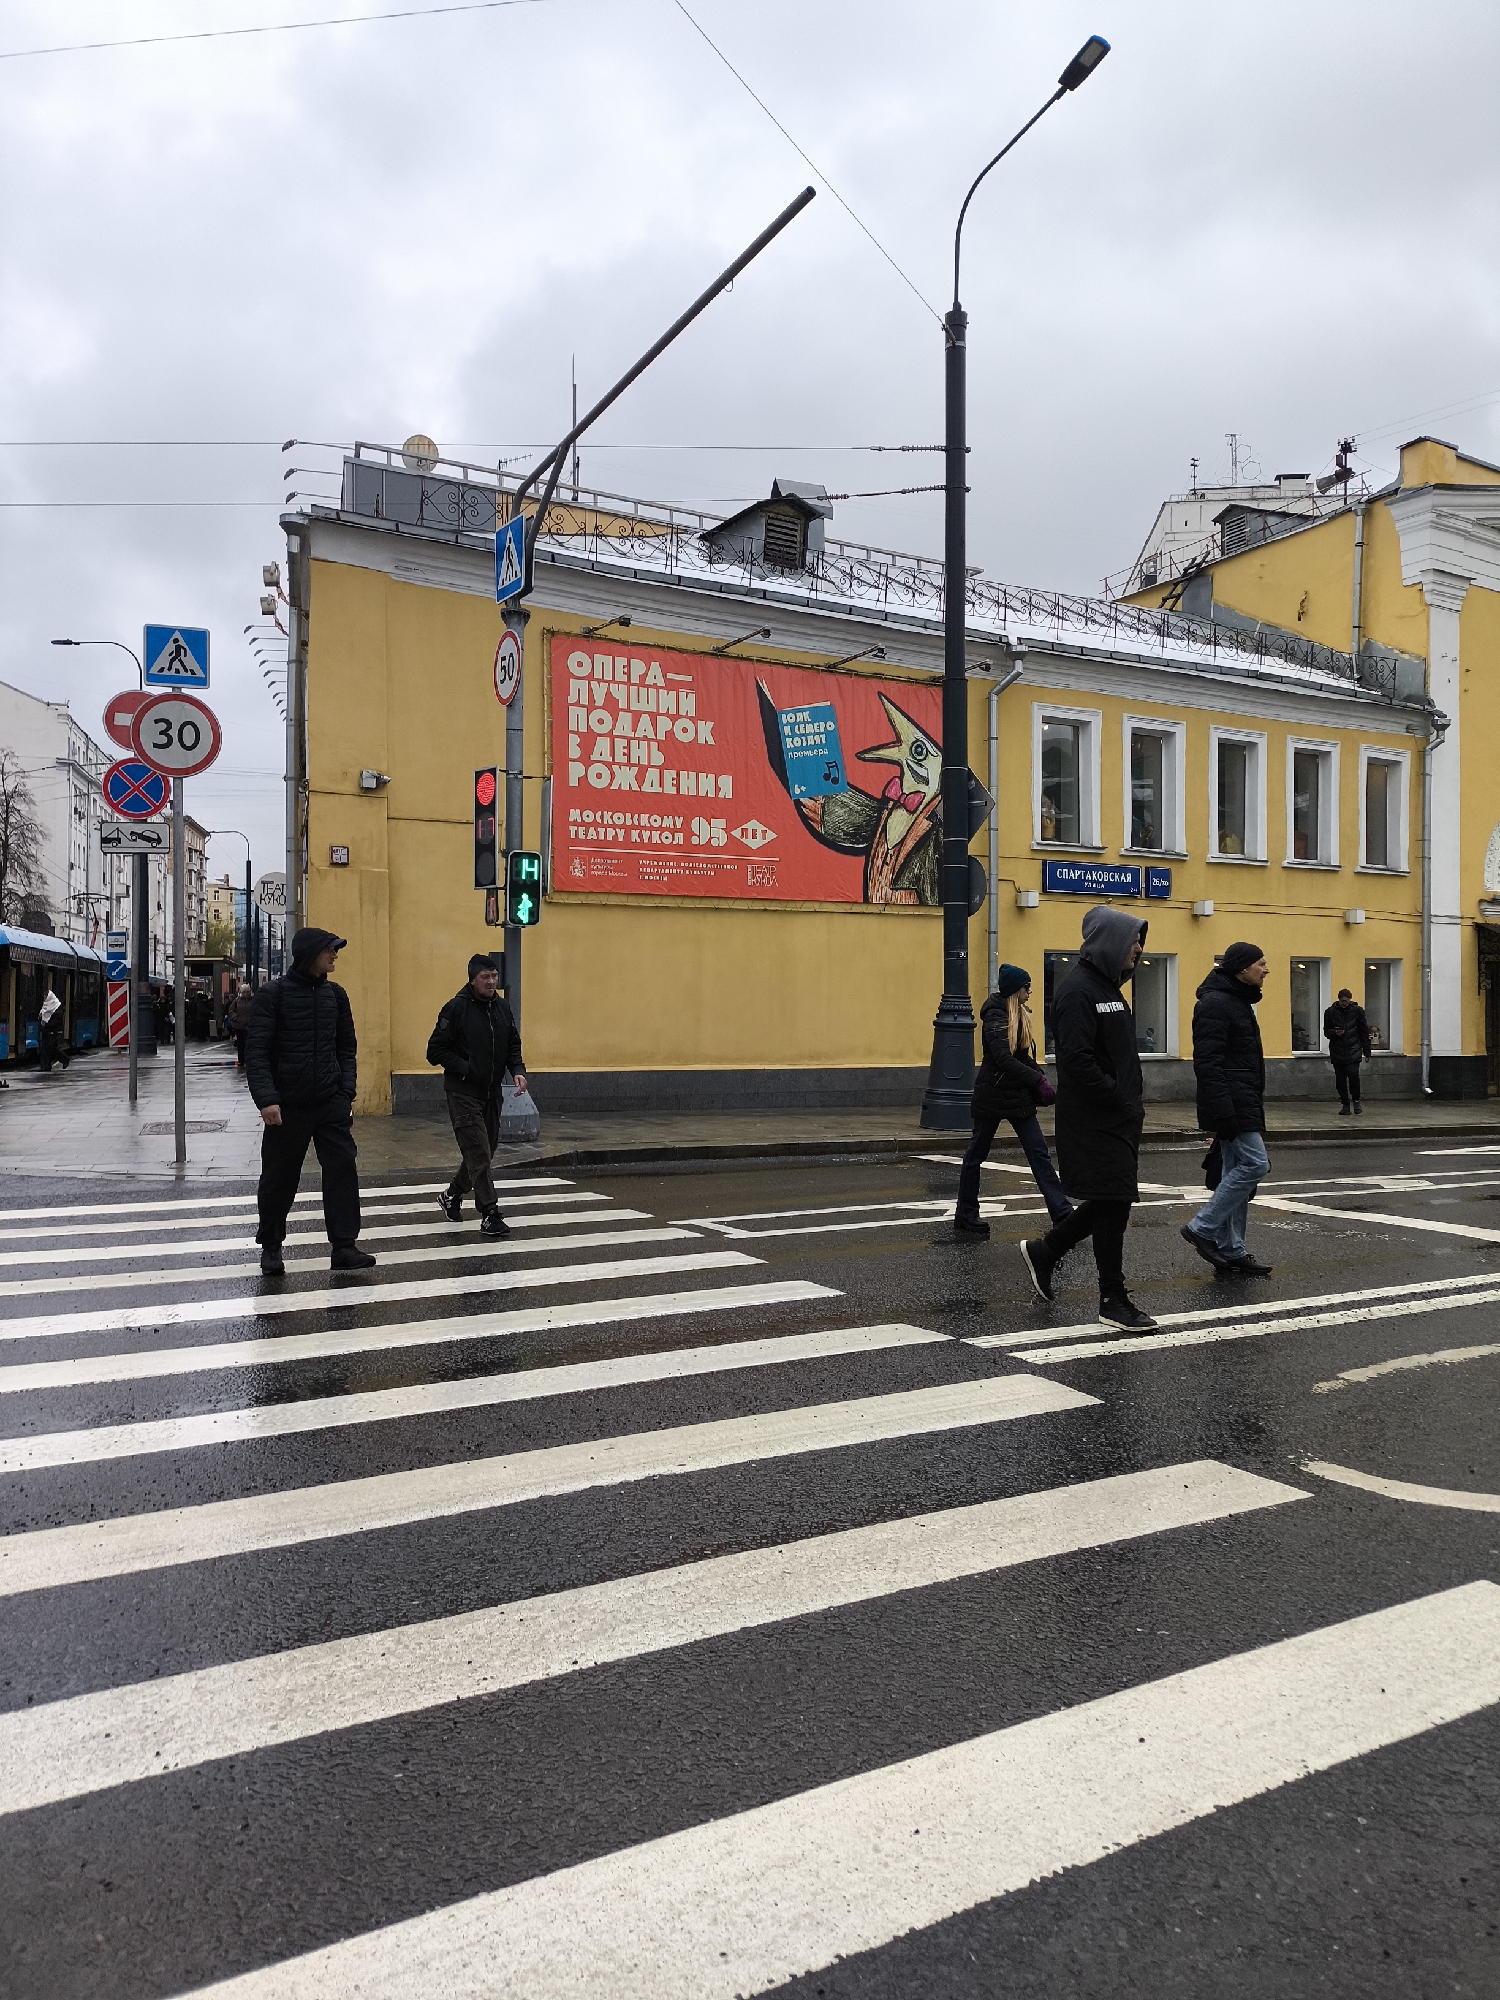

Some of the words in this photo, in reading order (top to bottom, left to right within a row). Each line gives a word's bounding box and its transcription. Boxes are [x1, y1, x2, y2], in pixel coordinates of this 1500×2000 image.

[500, 652, 515, 685] 50
[567, 678, 696, 717] ЛУЧШИЙ
[568, 706, 716, 745] ПОДАРОК
[781, 710, 812, 724] ВОЛК
[153, 718, 201, 751] 30
[783, 725, 792, 736] И
[794, 721, 835, 735] СЕМЕРО
[568, 733, 582, 759] В
[590, 736, 665, 766] ДЕНЬ
[786, 734, 827, 749] КОЗЛЯТ
[788, 748, 829, 760] премьера
[568, 761, 734, 799] РОЖДЕНИЯ
[794, 784, 807, 795] 6+
[568, 808, 684, 829] МОСКОВСКОМУ
[568, 825, 626, 842] ТЕАТРУ
[631, 829, 684, 845] КУКОЛ
[691, 816, 728, 847] 95
[739, 827, 768, 841] ЛЕТ
[521, 858, 539, 881] 14
[1056, 868, 1132, 883] СПАРТАКОВСКАЯ
[261, 882, 286, 895] ТЕАТ
[260, 894, 287, 906] КУКО
